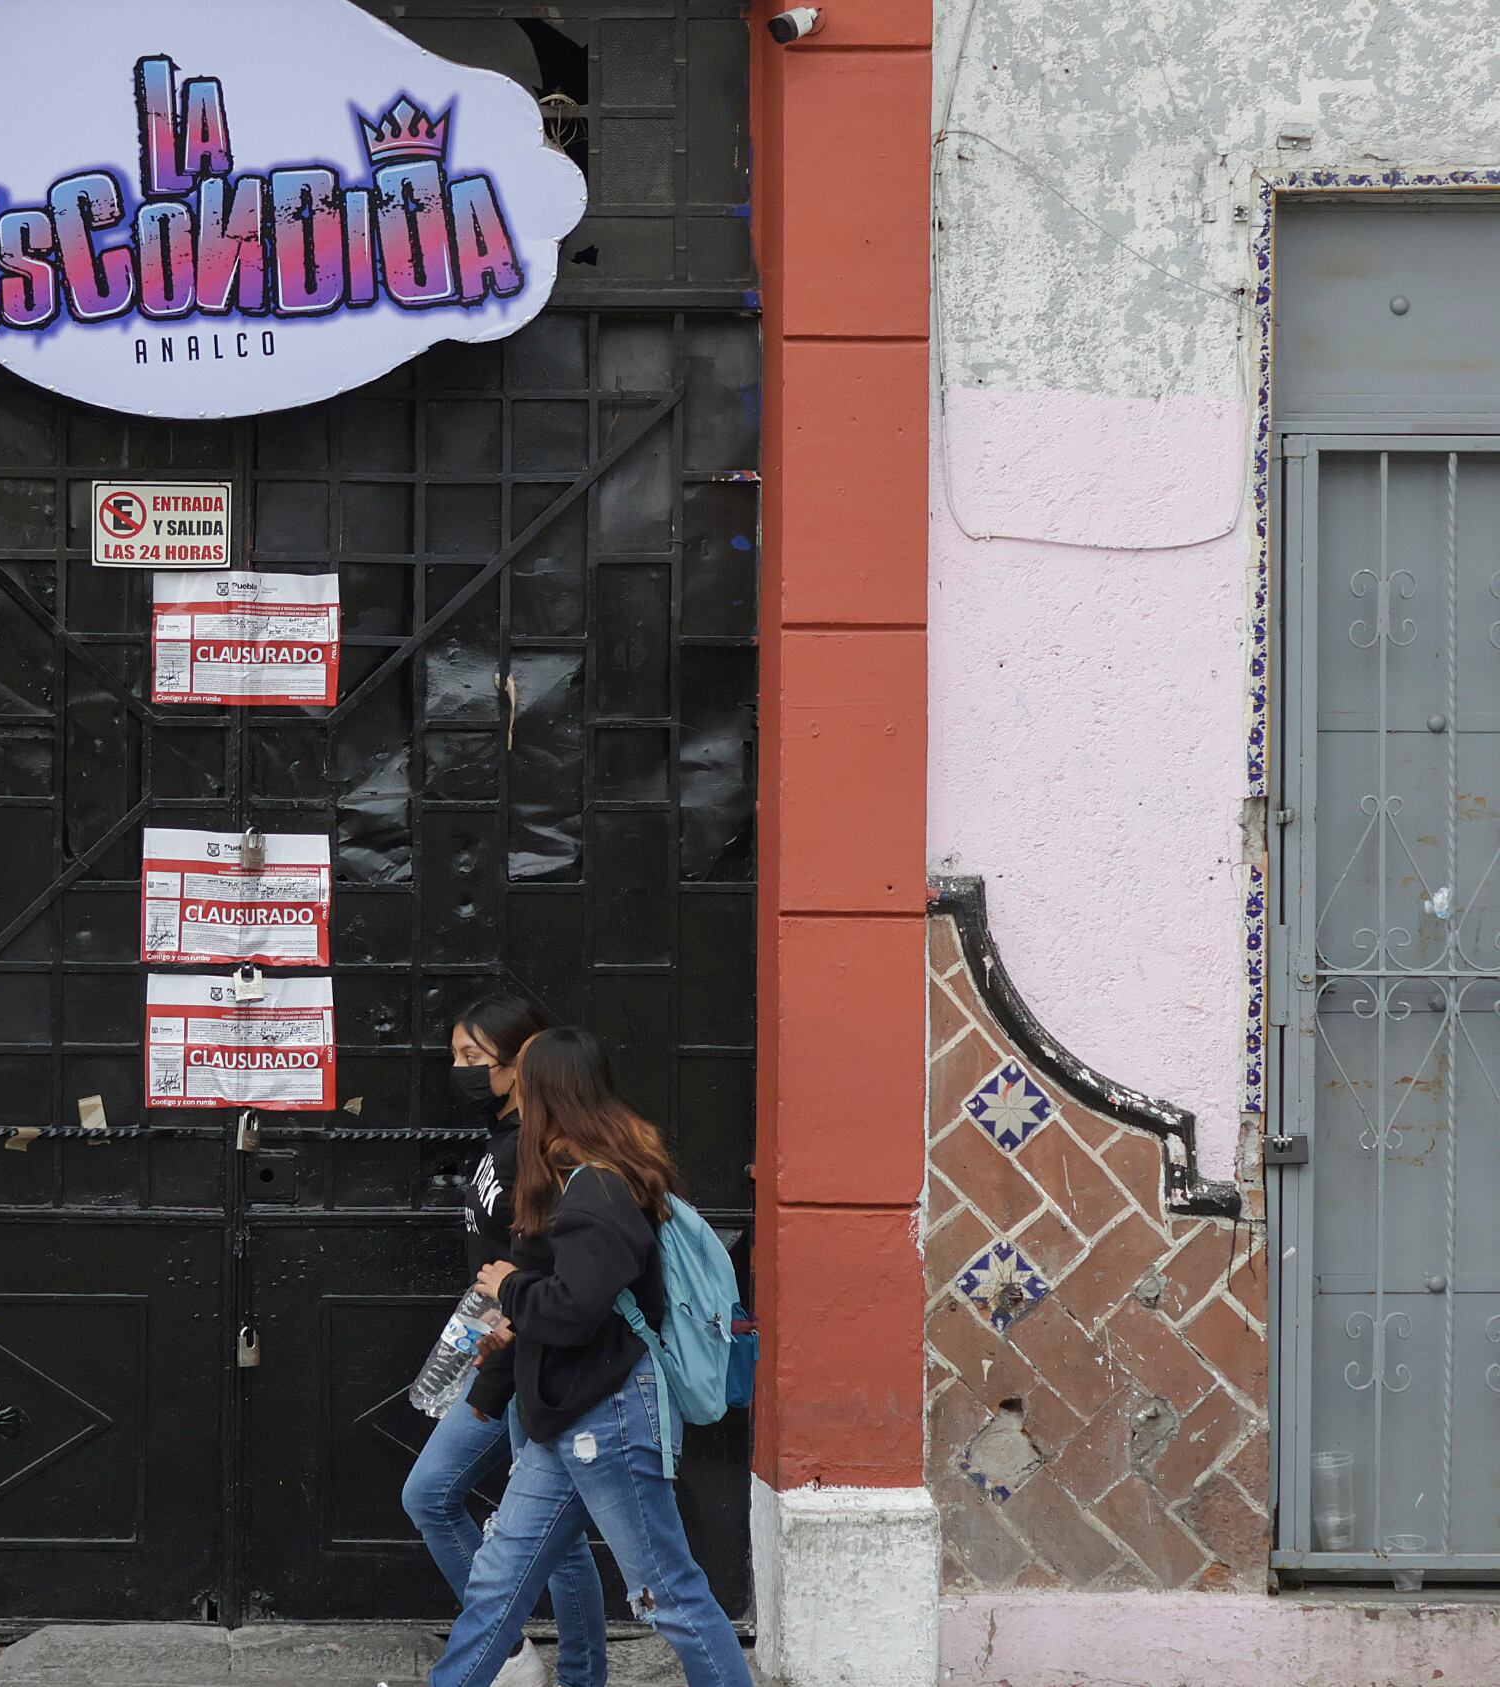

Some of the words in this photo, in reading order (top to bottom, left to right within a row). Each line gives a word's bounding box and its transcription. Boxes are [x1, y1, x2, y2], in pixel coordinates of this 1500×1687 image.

[134, 54, 232, 197] LA
[135, 331, 276, 365] ANALCO
[152, 496, 224, 513] ENTRADA
[153, 520, 164, 536] Y
[167, 520, 224, 536] SALIDA
[104, 544, 136, 560] LAS
[139, 545, 162, 560] 24
[165, 545, 224, 561] HORAS
[195, 645, 324, 664] CLAUSURADO
[156, 694, 182, 702] Contigo
[183, 695, 188, 703] y
[202, 695, 221, 703] rumbo
[185, 904, 314, 925] CLAUSURADO
[146, 953, 170, 961] Contigo
[189, 1049, 319, 1069] CLAUSURADO
[151, 1099, 176, 1107] Contigo
